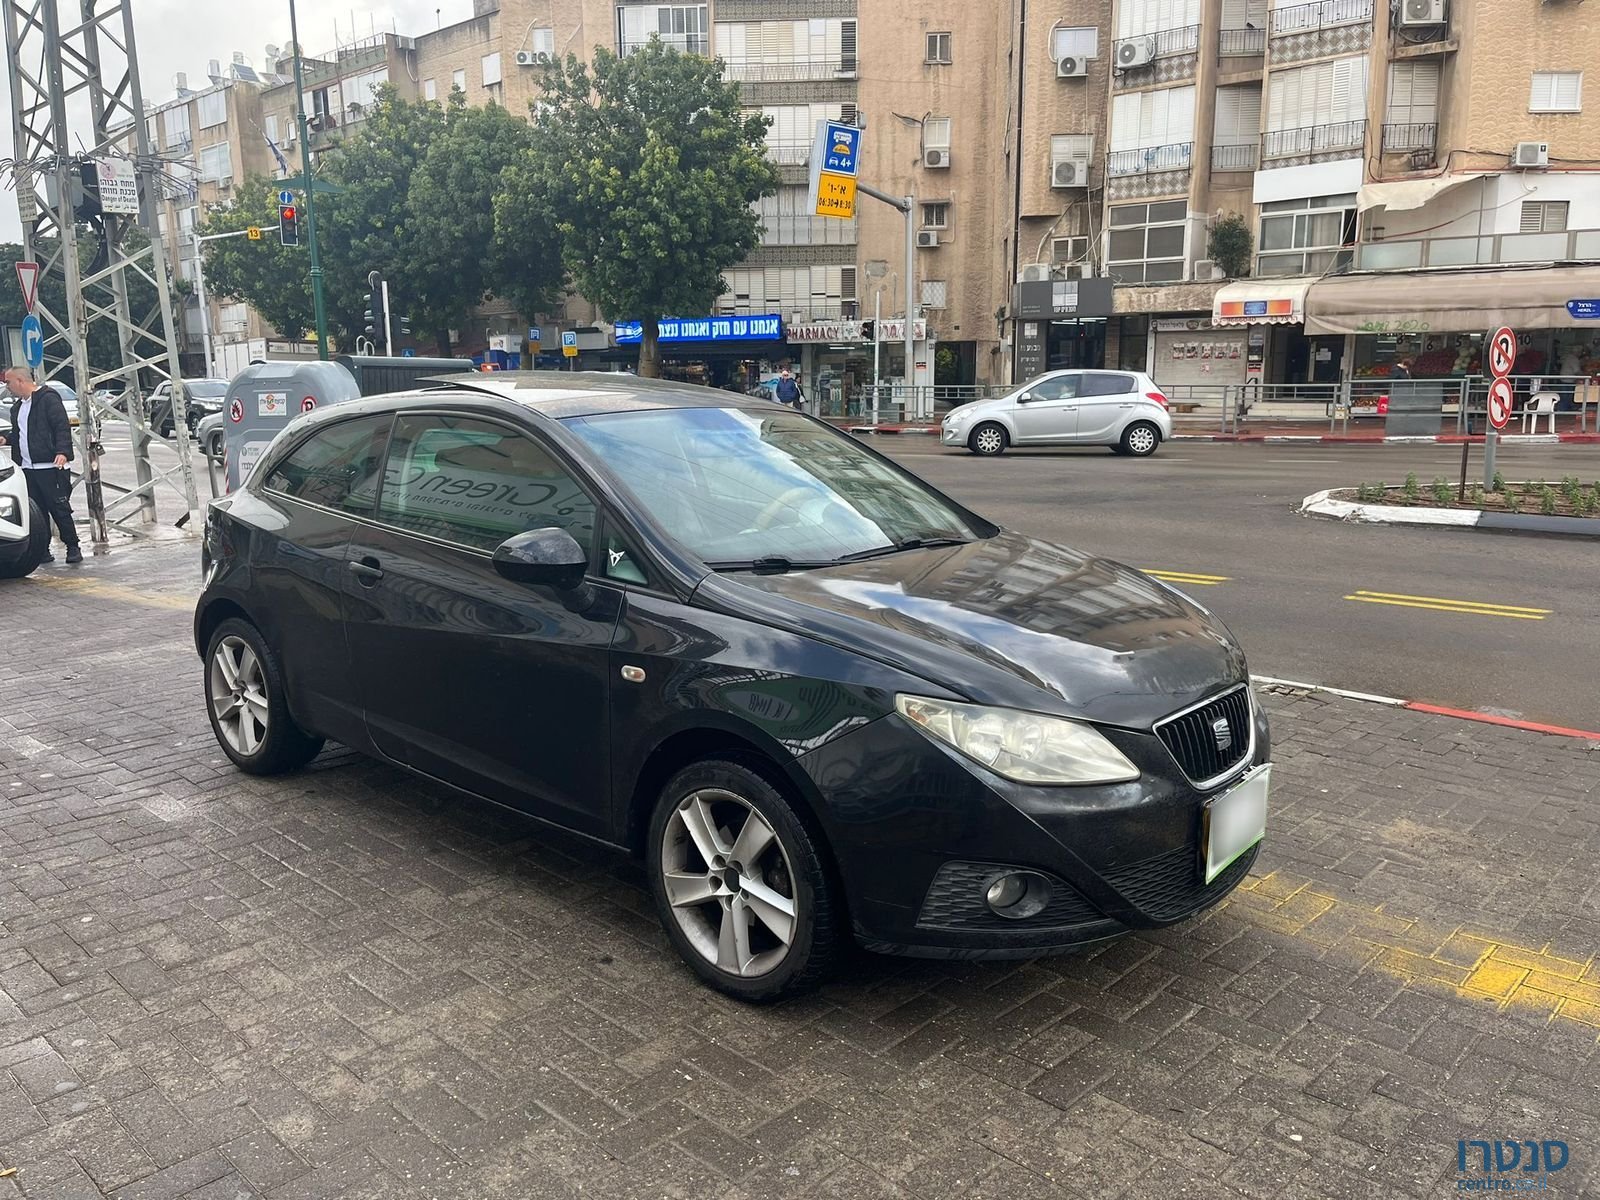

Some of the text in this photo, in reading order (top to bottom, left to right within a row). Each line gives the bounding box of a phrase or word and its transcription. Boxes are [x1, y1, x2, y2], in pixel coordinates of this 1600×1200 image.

[840, 158, 852, 167] 4+
[120, 180, 135, 188] מתח
[119, 188, 136, 196] סכנת
[249, 229, 259, 237] 13
[681, 323, 709, 337] ואנחנו
[712, 321, 730, 338] חזק
[733, 321, 747, 336] עם
[750, 319, 778, 335] אנחנו
[787, 324, 839, 340] PHARMACY
